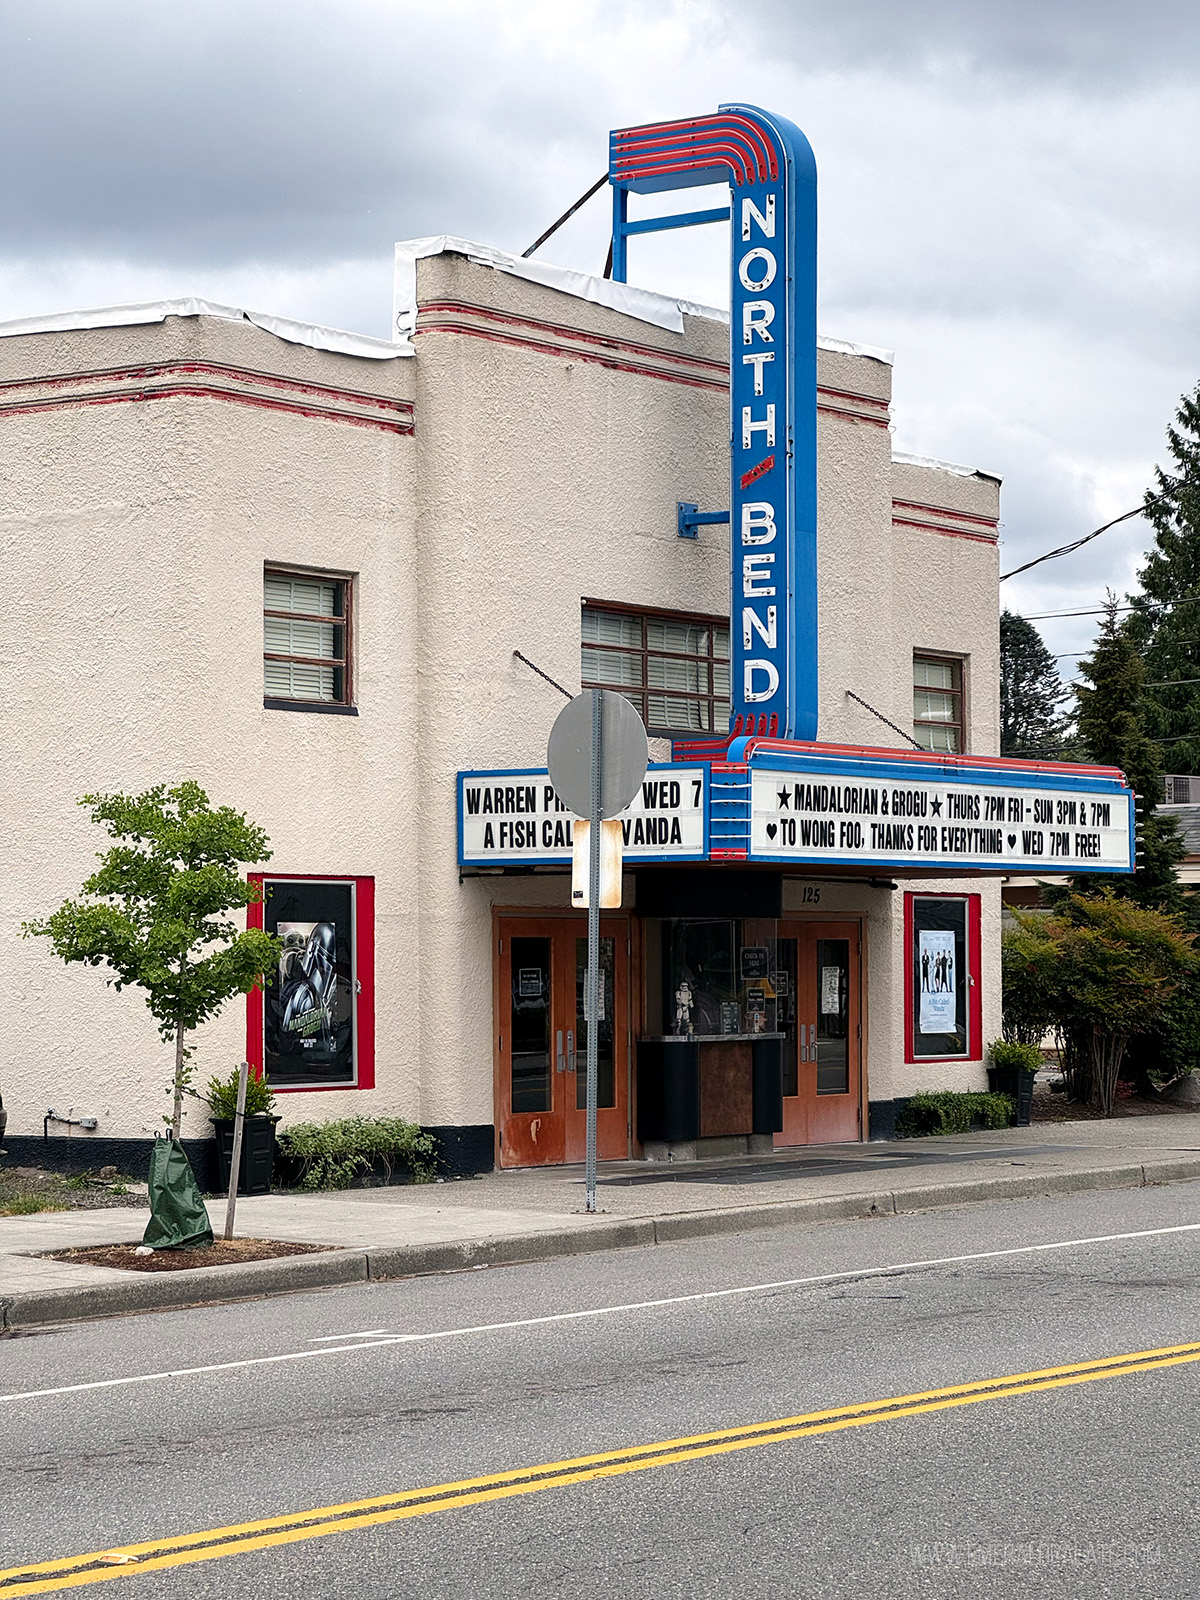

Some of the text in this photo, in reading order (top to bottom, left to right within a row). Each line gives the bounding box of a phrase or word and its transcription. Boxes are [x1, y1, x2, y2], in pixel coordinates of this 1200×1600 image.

[738, 194, 780, 703] NORTH BEND
[466, 786, 536, 815] WARREN
[642, 780, 680, 809] WED
[692, 780, 702, 808] 7
[794, 783, 878, 816] MANDALORIAN
[881, 788, 889, 816] &
[891, 789, 928, 818] GROGU
[946, 793, 980, 820] THURS
[984, 795, 1005, 821] 7PM
[1056, 800, 1077, 826] 3PM
[1080, 801, 1087, 826] &
[1091, 802, 1111, 827] 7PM
[484, 822, 495, 849] A
[500, 820, 537, 848] FISH
[780, 818, 1101, 858] TO WONG FOO, THANKS FOR EVERYTHING WED 7PM FREE!
[801, 886, 821, 904] 125
